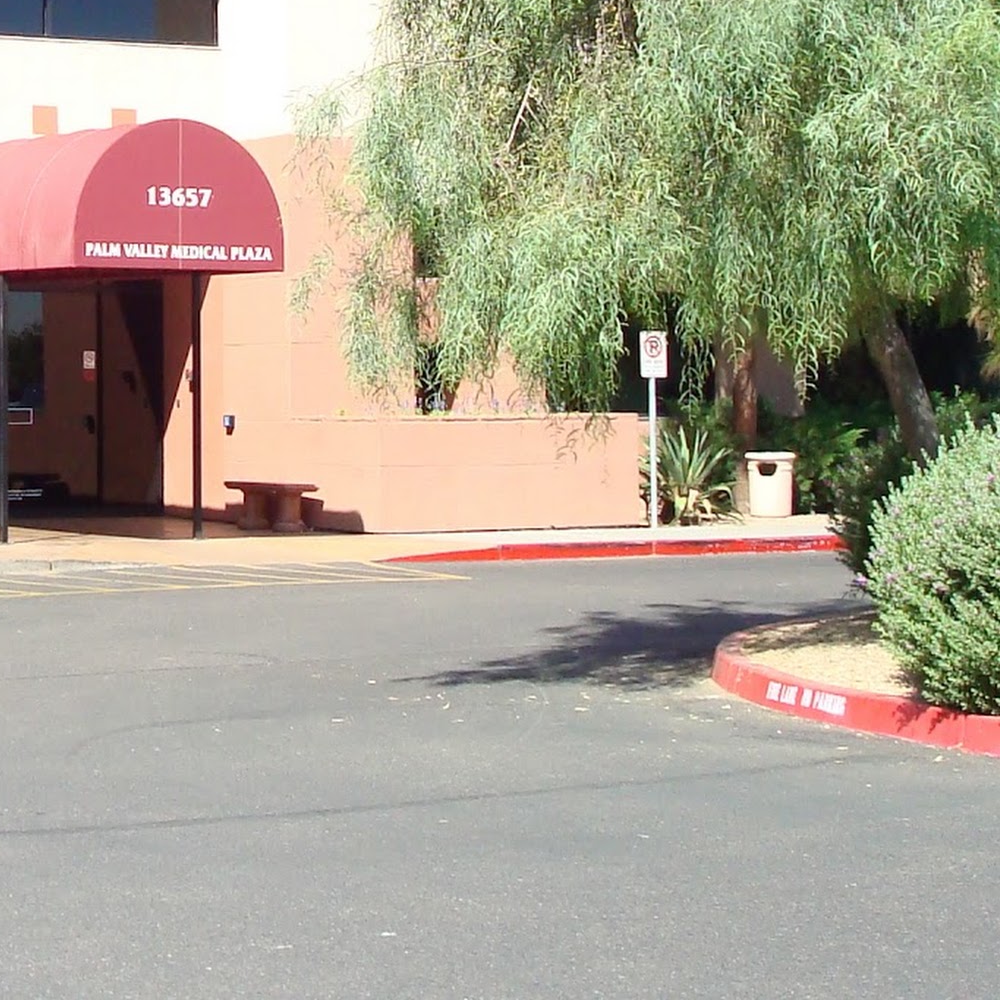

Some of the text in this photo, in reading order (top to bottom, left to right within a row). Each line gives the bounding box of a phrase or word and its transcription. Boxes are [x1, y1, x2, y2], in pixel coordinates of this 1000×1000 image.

[146, 185, 212, 208] 13657
[84, 241, 273, 262] PALM VALLEY MEDICAL PLAZA
